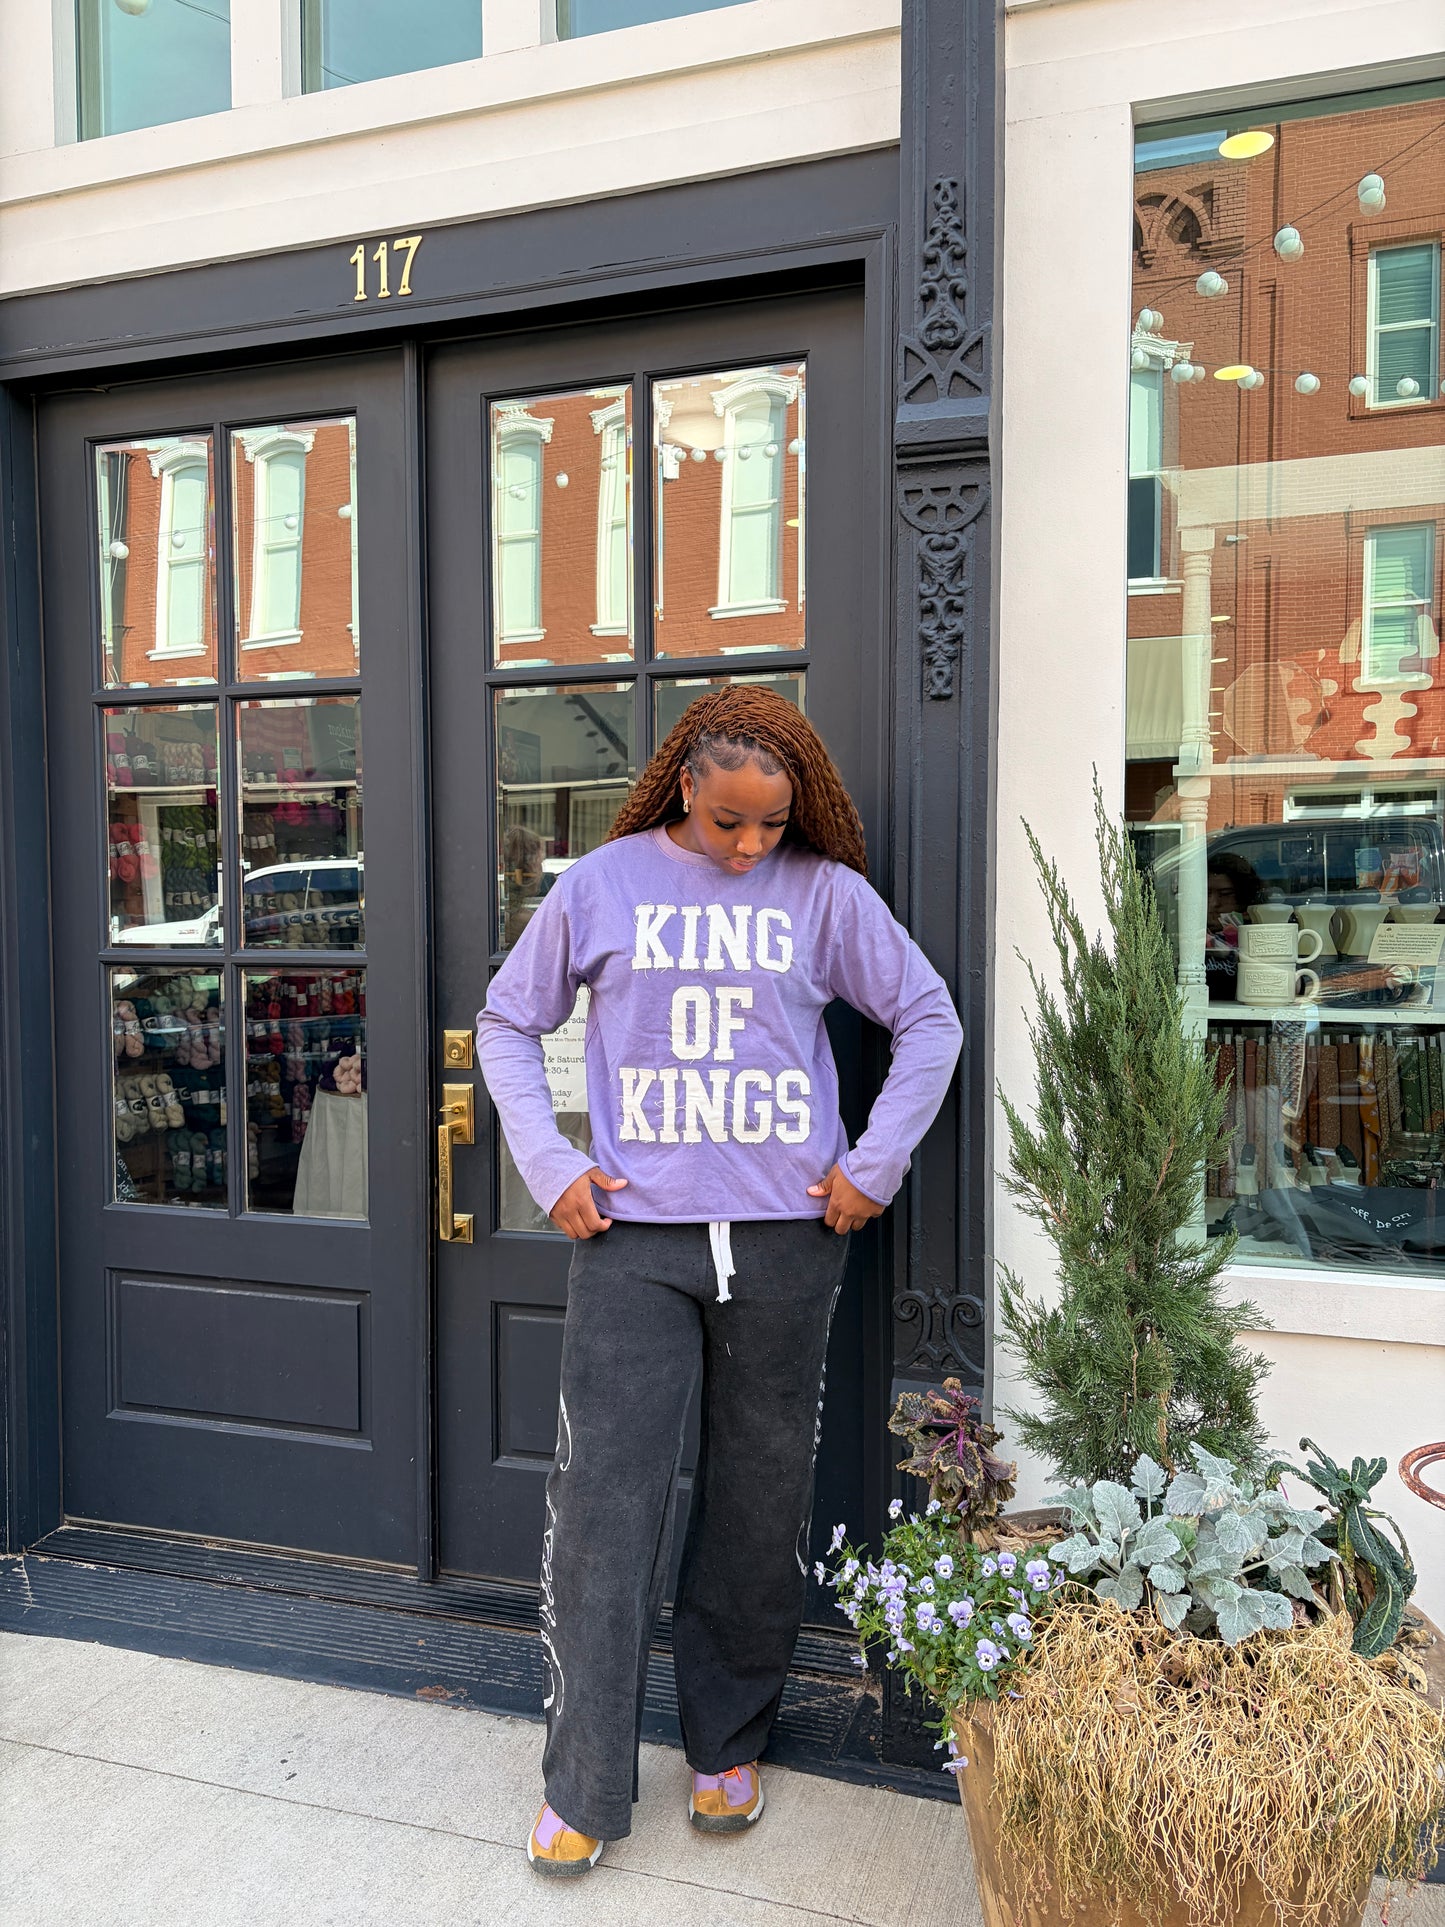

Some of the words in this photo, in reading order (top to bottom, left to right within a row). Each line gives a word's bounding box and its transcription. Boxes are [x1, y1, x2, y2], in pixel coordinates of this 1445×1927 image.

[349, 235, 423, 301] 117
[631, 903, 794, 974] KING
[671, 985, 753, 1062] OF
[547, 1055, 555, 1064] &
[556, 1055, 586, 1064] Saturd
[552, 1089, 572, 1098] nday
[553, 1099, 568, 1107] 2-4
[618, 1067, 812, 1145] KINGS
